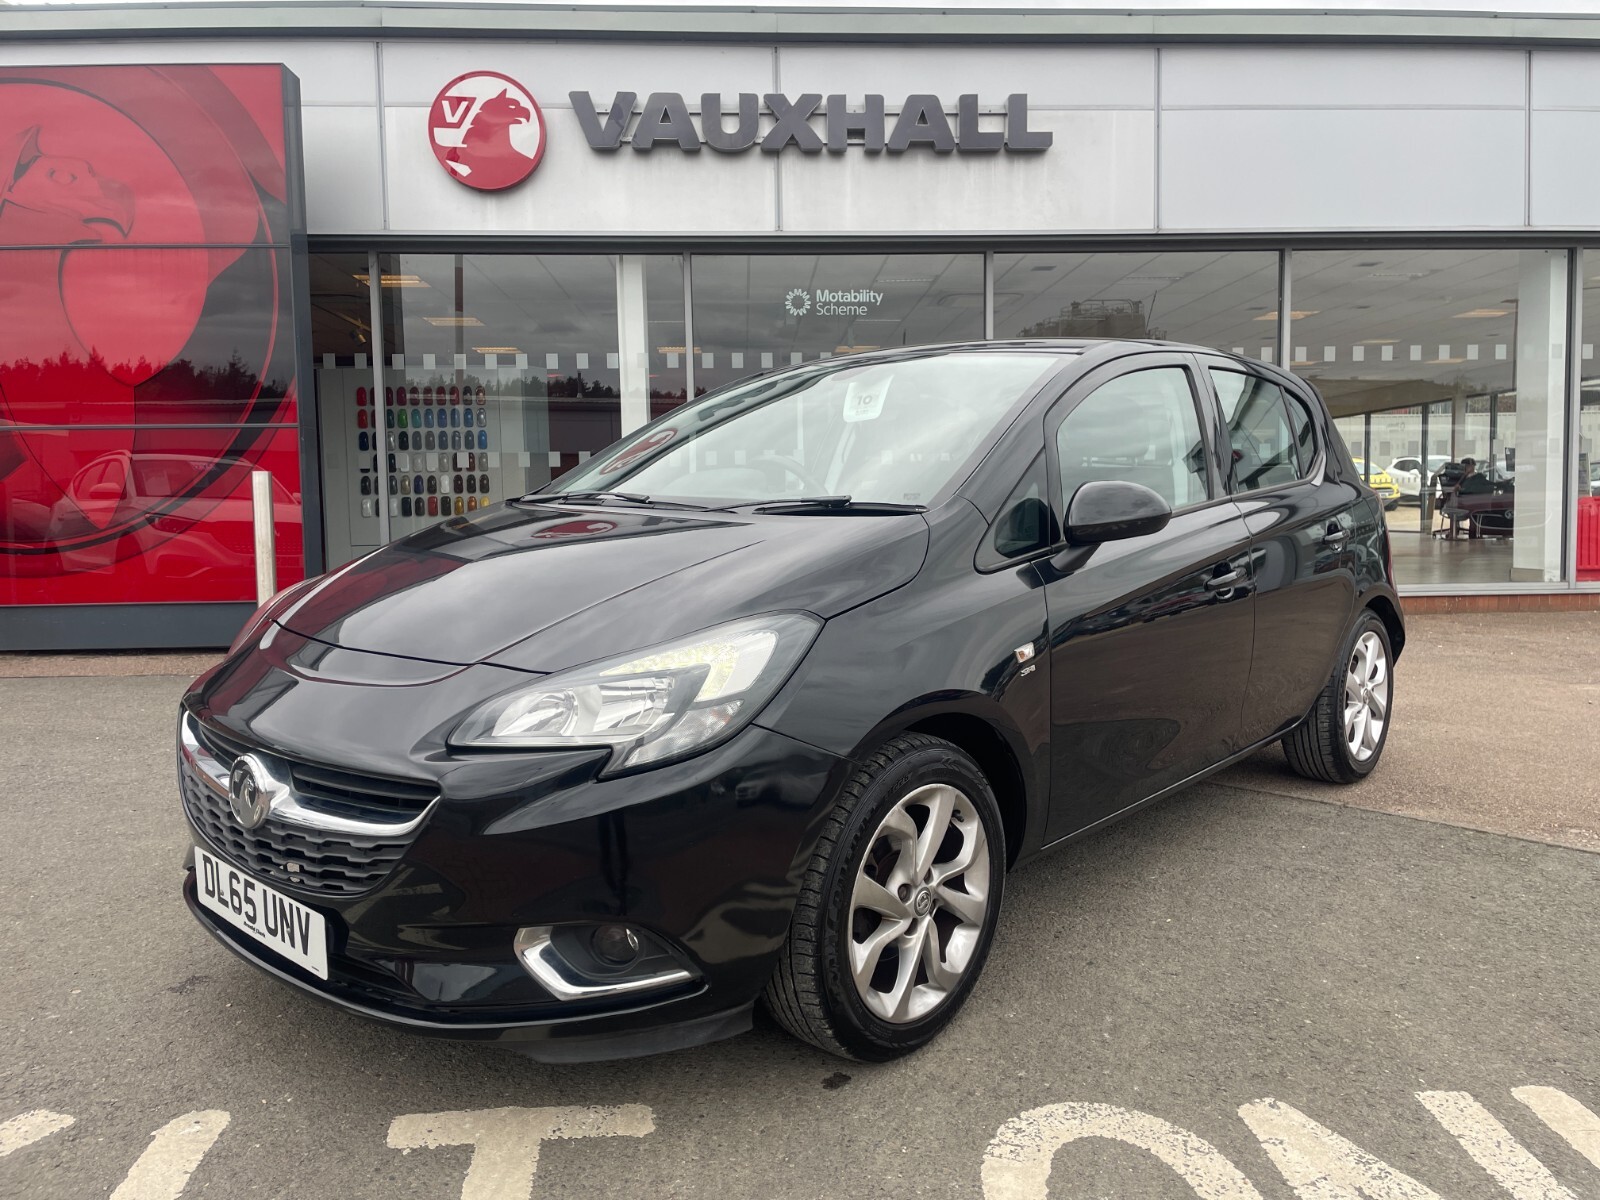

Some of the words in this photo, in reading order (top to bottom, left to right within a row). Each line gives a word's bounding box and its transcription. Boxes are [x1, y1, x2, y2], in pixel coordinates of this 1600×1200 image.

[568, 91, 1053, 154] VAUXHALL
[816, 289, 884, 306] Motability
[816, 303, 868, 316] Scheme
[202, 854, 257, 925] DL65
[263, 888, 310, 956] UNV
